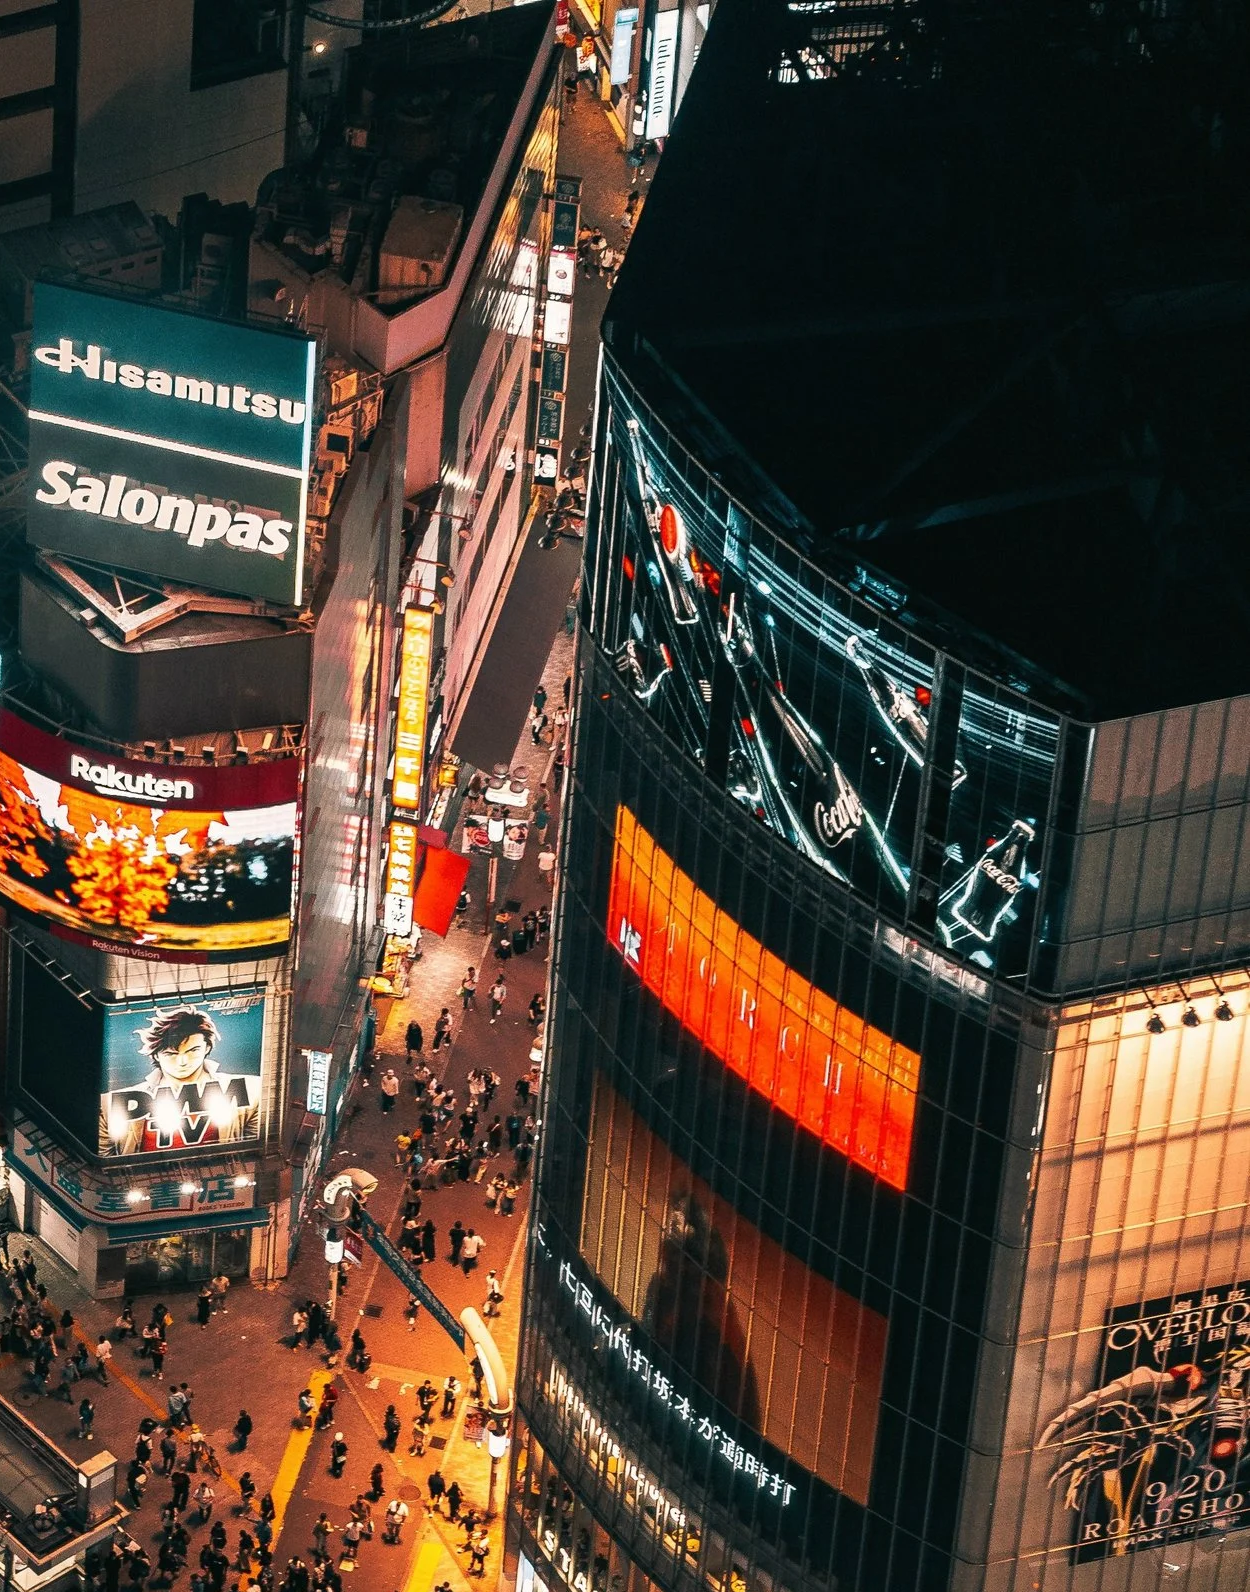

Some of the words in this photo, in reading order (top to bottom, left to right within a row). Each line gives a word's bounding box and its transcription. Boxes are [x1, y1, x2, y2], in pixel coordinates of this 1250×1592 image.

[34, 339, 306, 424] Hisamitsu
[36, 460, 293, 555] Salonpas
[70, 754, 193, 801] Rakuten
[92, 938, 129, 958] Rakuten
[131, 948, 160, 961] Vision
[111, 1077, 250, 1122] DMM
[147, 1114, 212, 1149] TV
[1083, 1490, 1250, 1541] ROADSHO
